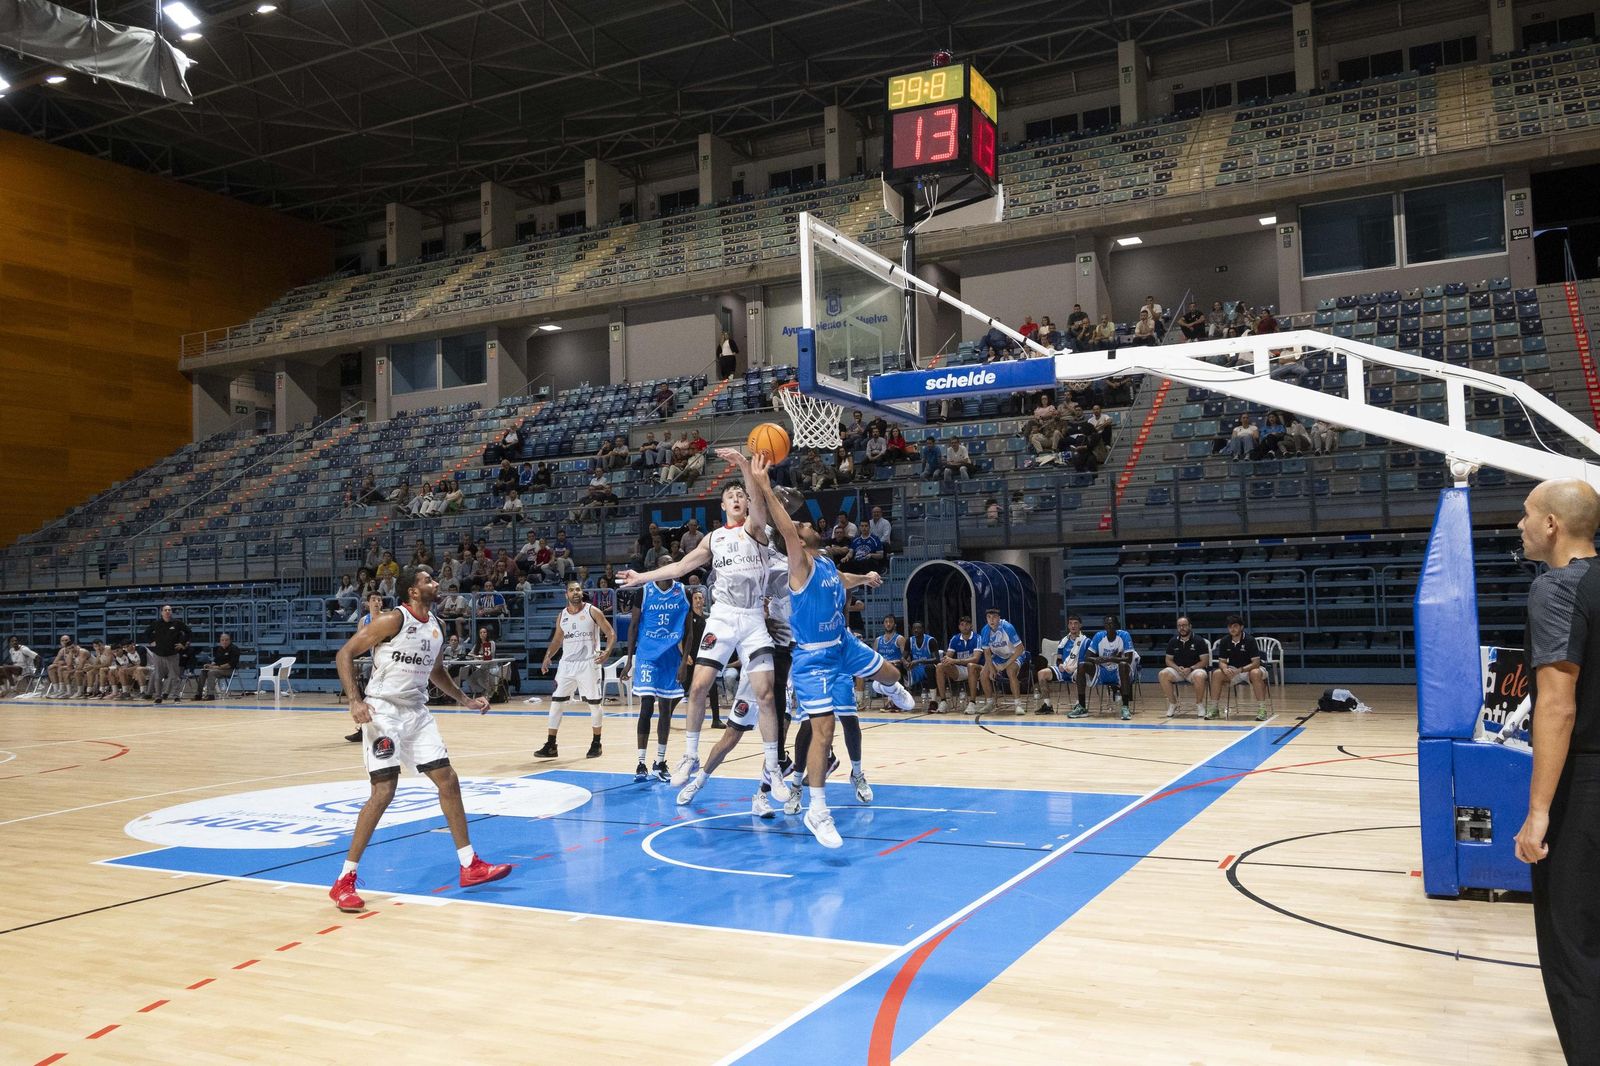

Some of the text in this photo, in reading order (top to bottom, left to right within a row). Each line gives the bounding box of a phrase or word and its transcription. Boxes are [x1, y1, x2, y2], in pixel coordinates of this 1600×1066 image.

[891, 72, 946, 106] 39:8
[915, 108, 957, 160] 13
[1512, 228, 1528, 237] BAR
[925, 370, 996, 391] schelde
[726, 541, 739, 554] 30
[658, 613, 670, 626] 35
[421, 640, 431, 651] 31
[641, 670, 652, 683] 35
